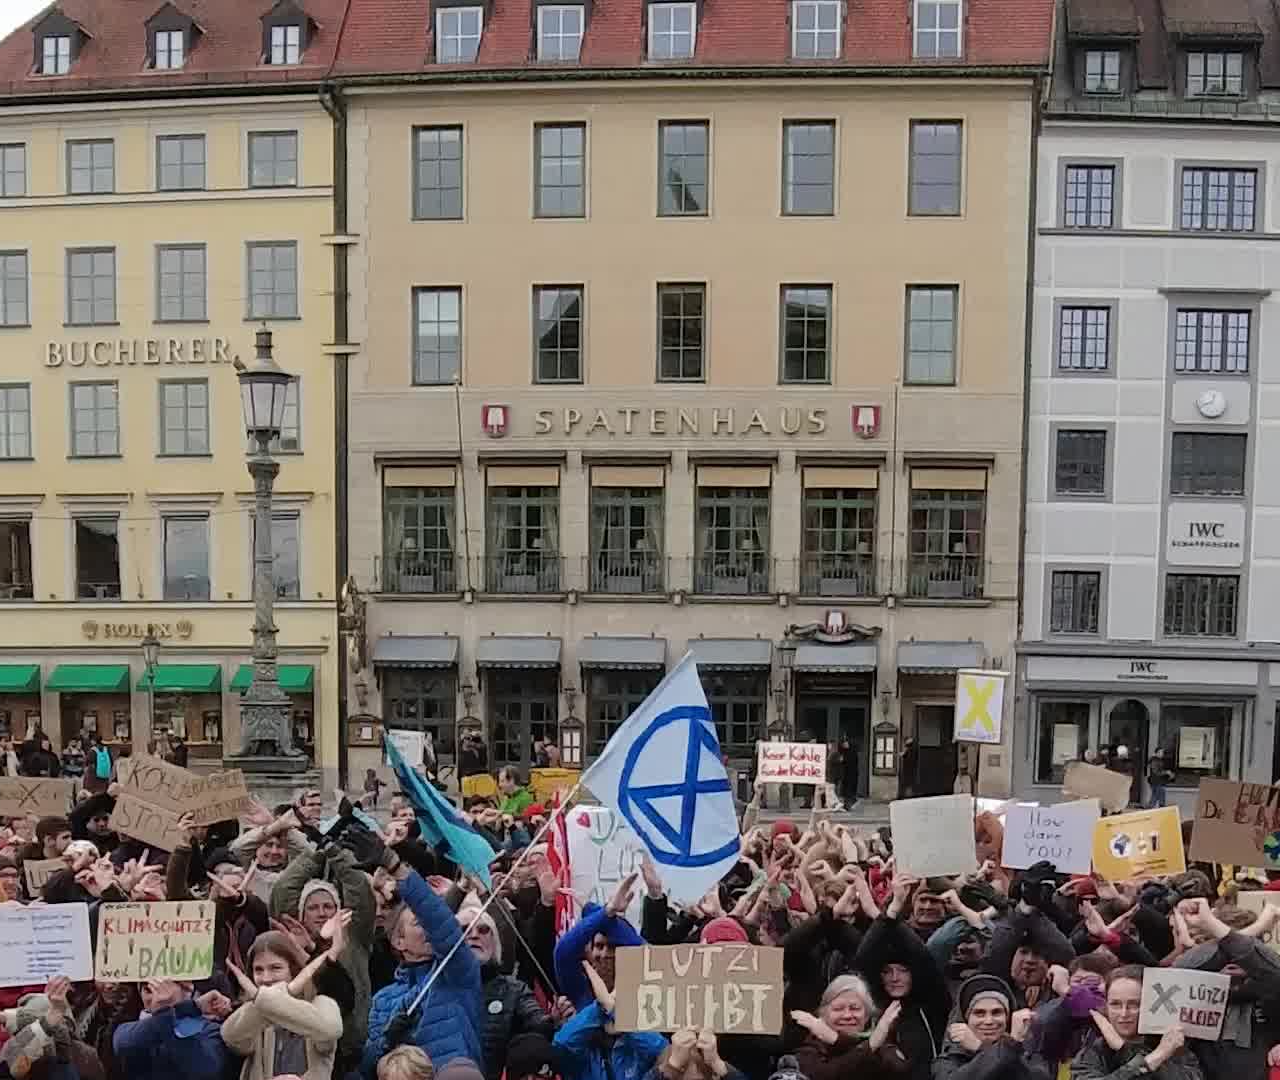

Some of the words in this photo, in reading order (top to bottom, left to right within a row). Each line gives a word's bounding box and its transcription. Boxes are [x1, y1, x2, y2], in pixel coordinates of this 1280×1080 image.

[44, 337, 233, 367] BUCHERER
[535, 408, 826, 435] SPATENHAUS
[1189, 523, 1225, 537] IWC
[1130, 662, 1157, 673] IWC
[1028, 809, 1064, 828] How
[1024, 830, 1062, 841] dare
[137, 944, 215, 979] BAUM
